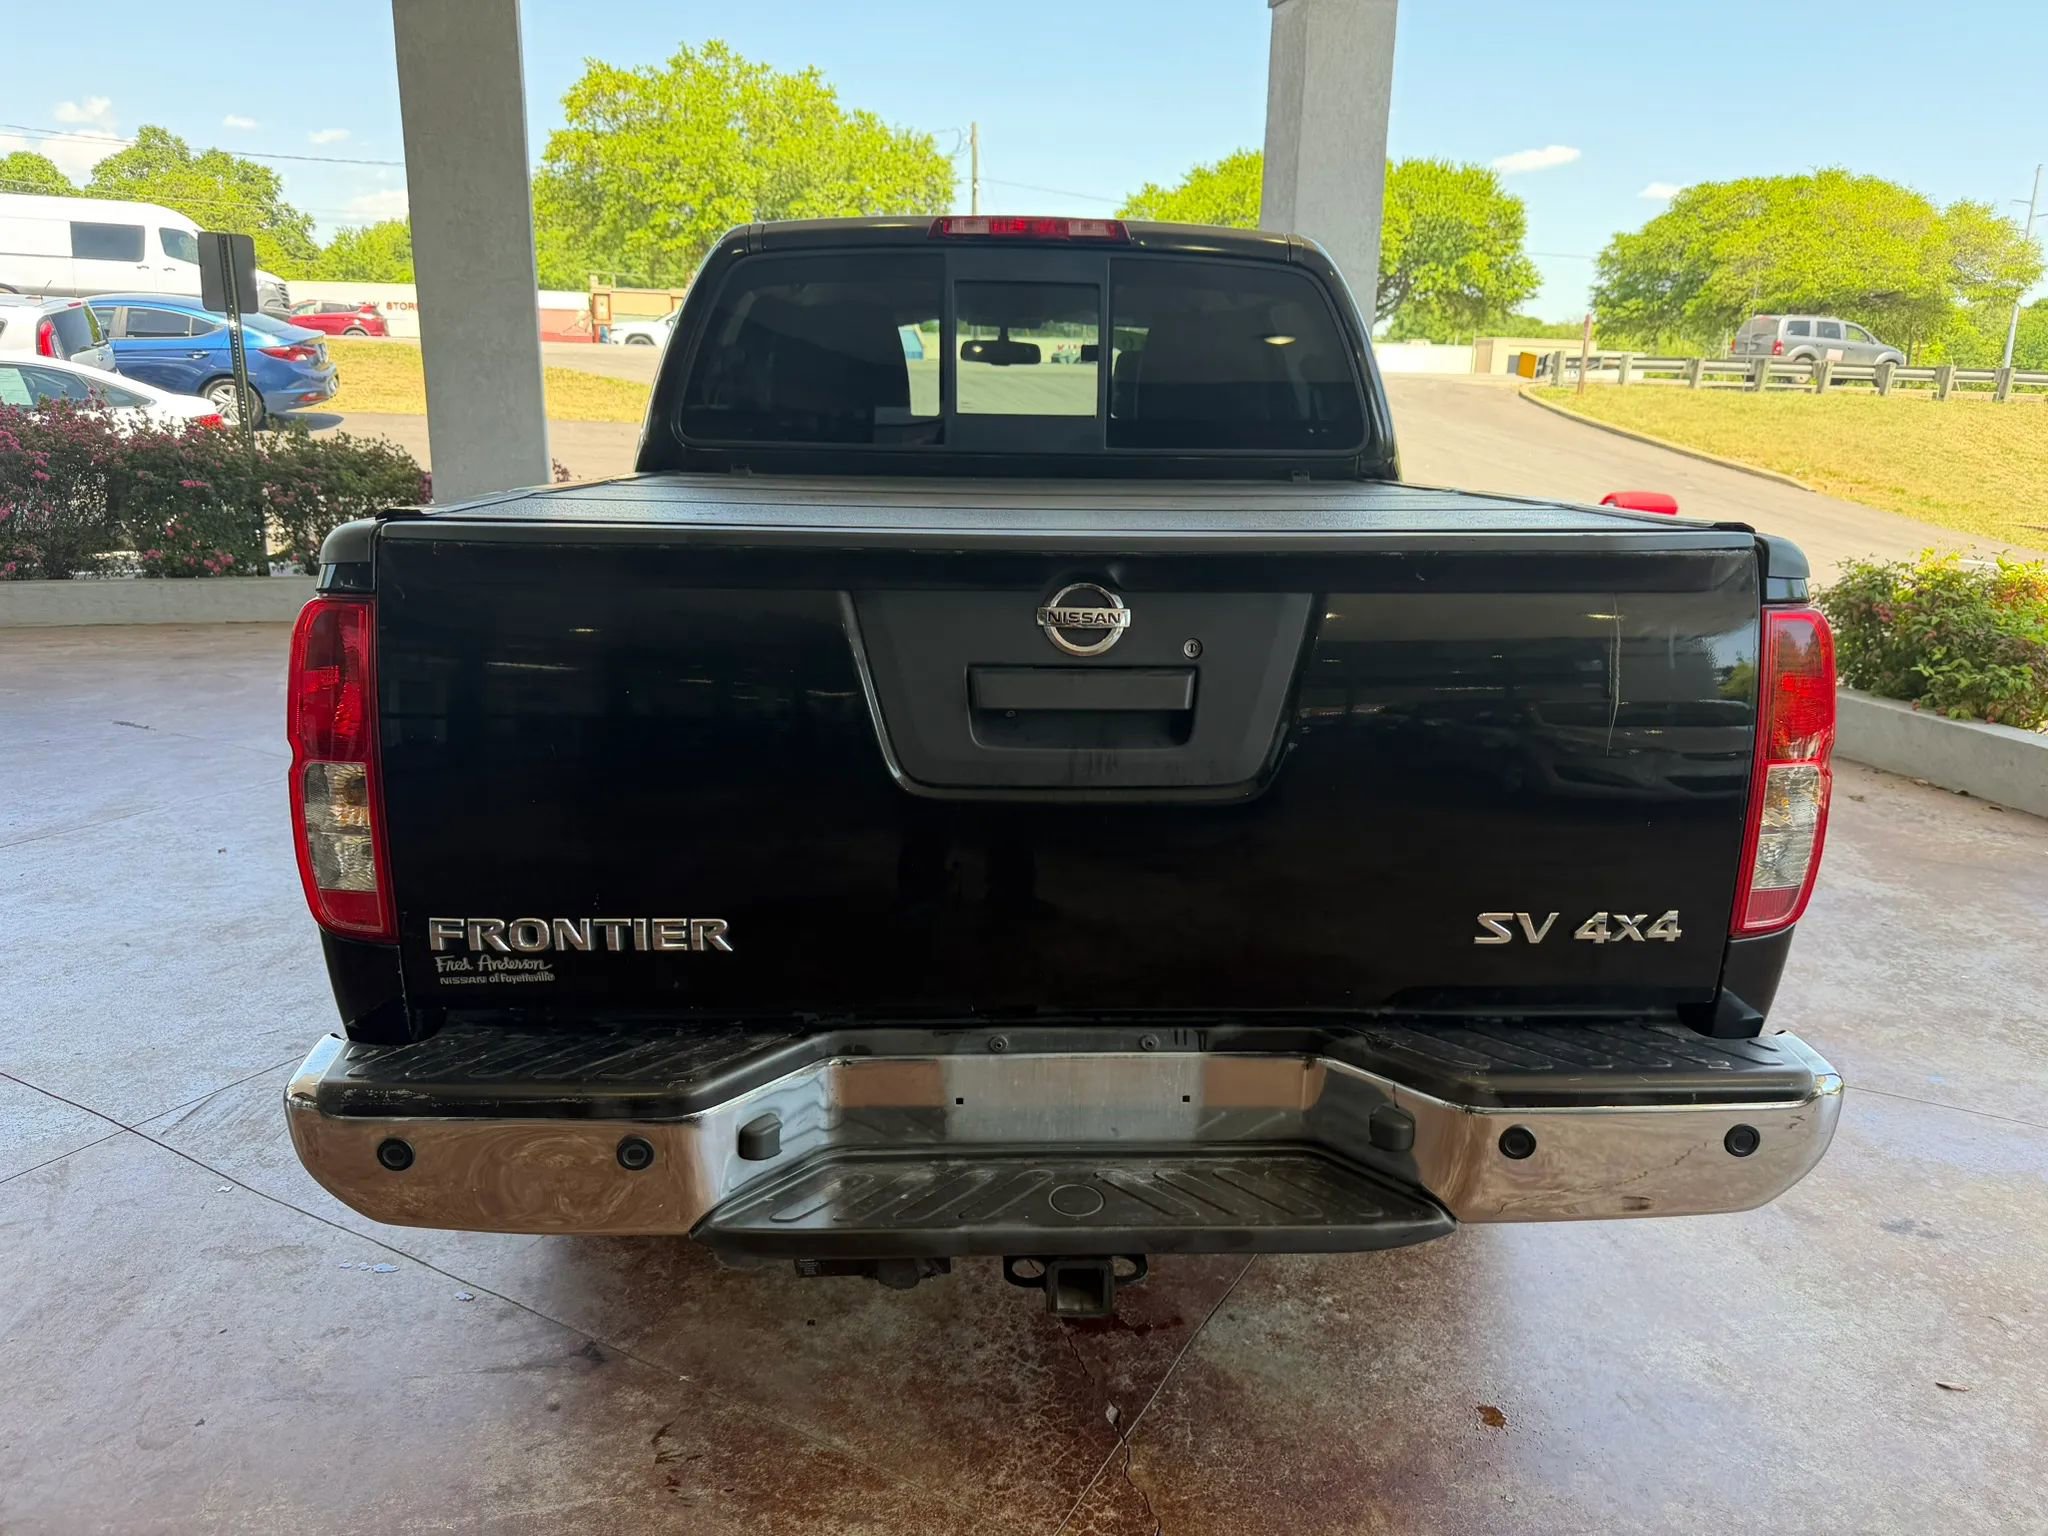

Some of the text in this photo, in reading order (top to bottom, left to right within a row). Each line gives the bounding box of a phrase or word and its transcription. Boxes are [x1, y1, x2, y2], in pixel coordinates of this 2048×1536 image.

[386, 302, 418, 310] STOR
[1047, 611, 1121, 624] NISSAN
[428, 916, 734, 952] FRONTIER
[1473, 911, 1560, 945] SV
[434, 953, 553, 973] Fred Anderson
[439, 971, 556, 985] NISSAN of Fayetteville
